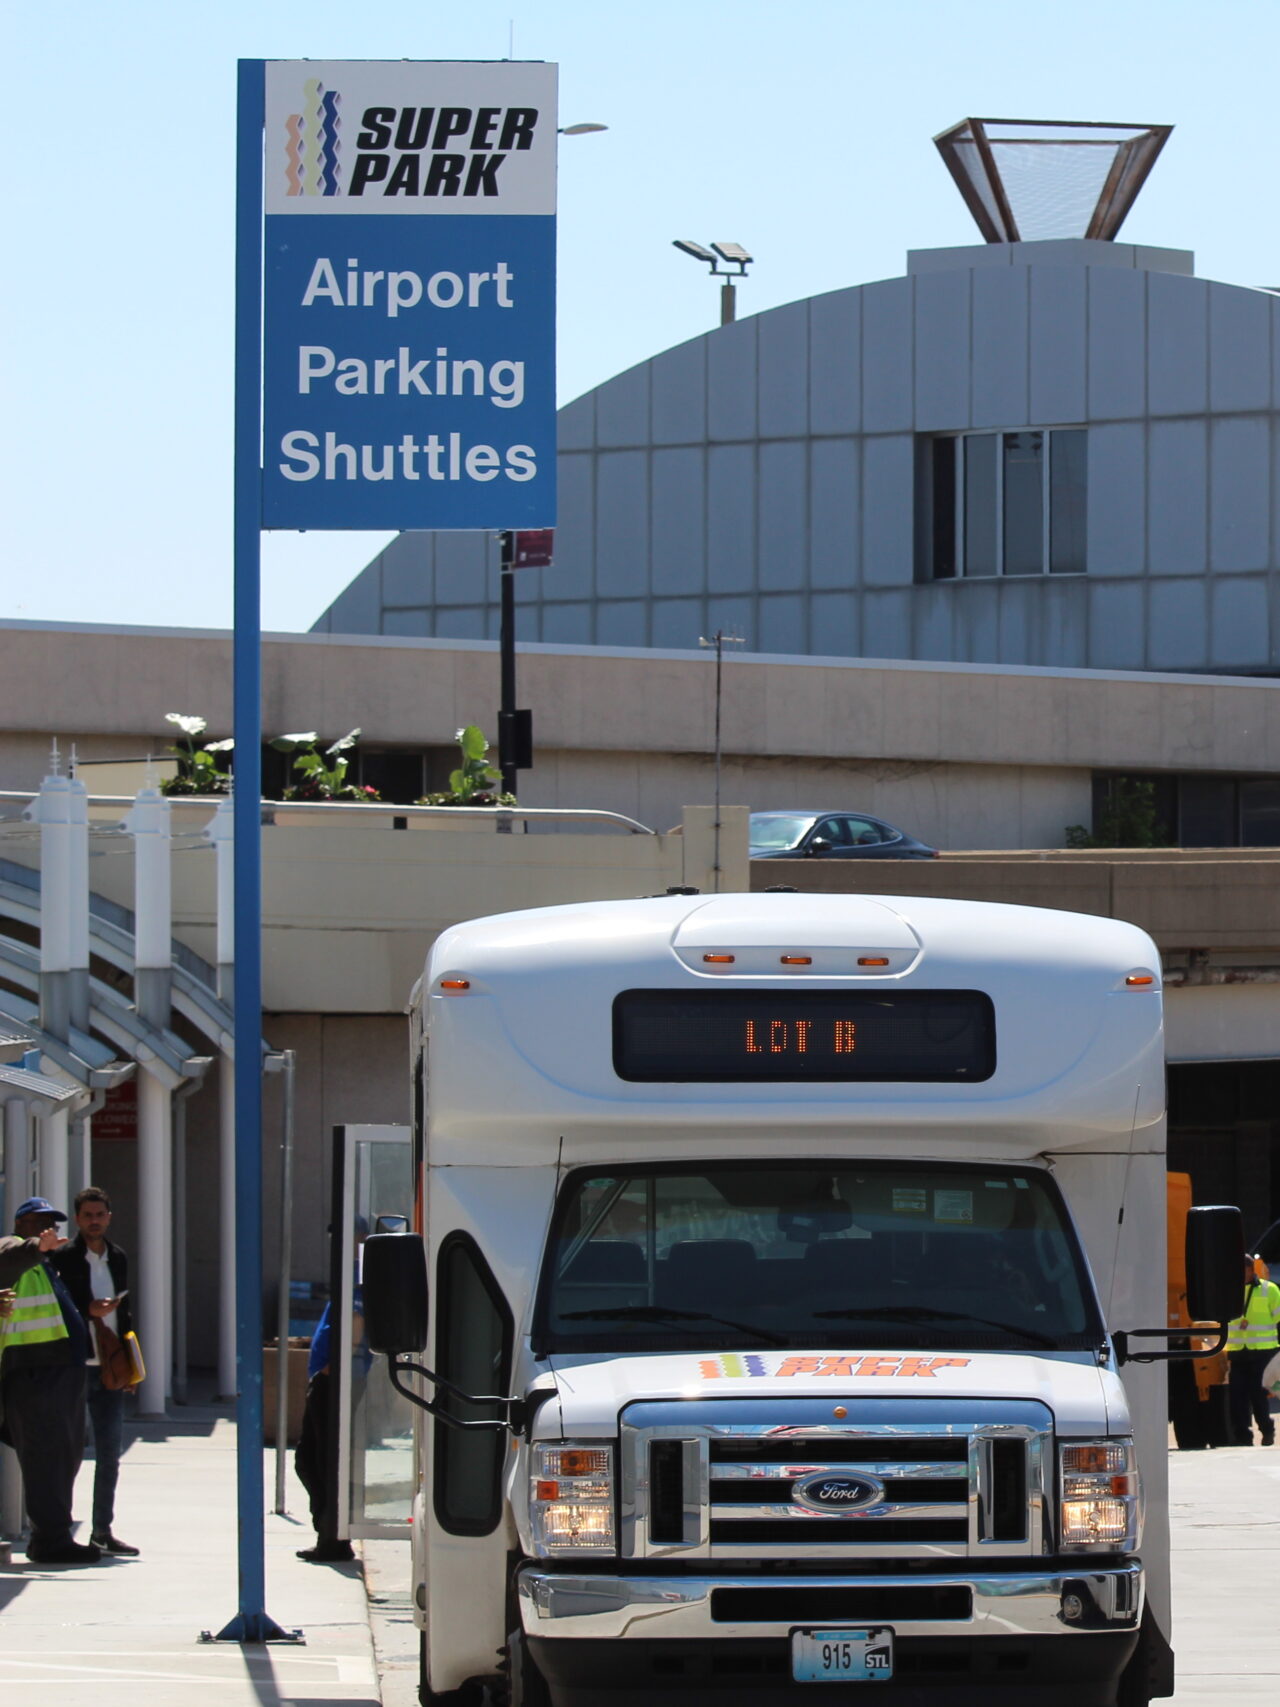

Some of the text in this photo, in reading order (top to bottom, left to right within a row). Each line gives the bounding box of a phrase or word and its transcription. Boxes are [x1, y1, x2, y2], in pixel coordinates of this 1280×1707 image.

[356, 107, 539, 150] SUPER
[348, 154, 507, 197] PARK
[301, 258, 514, 317] Airport
[298, 345, 525, 408] Parking
[279, 430, 537, 482] Shuttles
[746, 1020, 856, 1053] LOT B
[774, 1364, 940, 1378] PARK
[780, 1356, 971, 1367] SUPER
[819, 1482, 859, 1499] Ford
[823, 1643, 851, 1670] 915
[866, 1654, 889, 1668] STL
